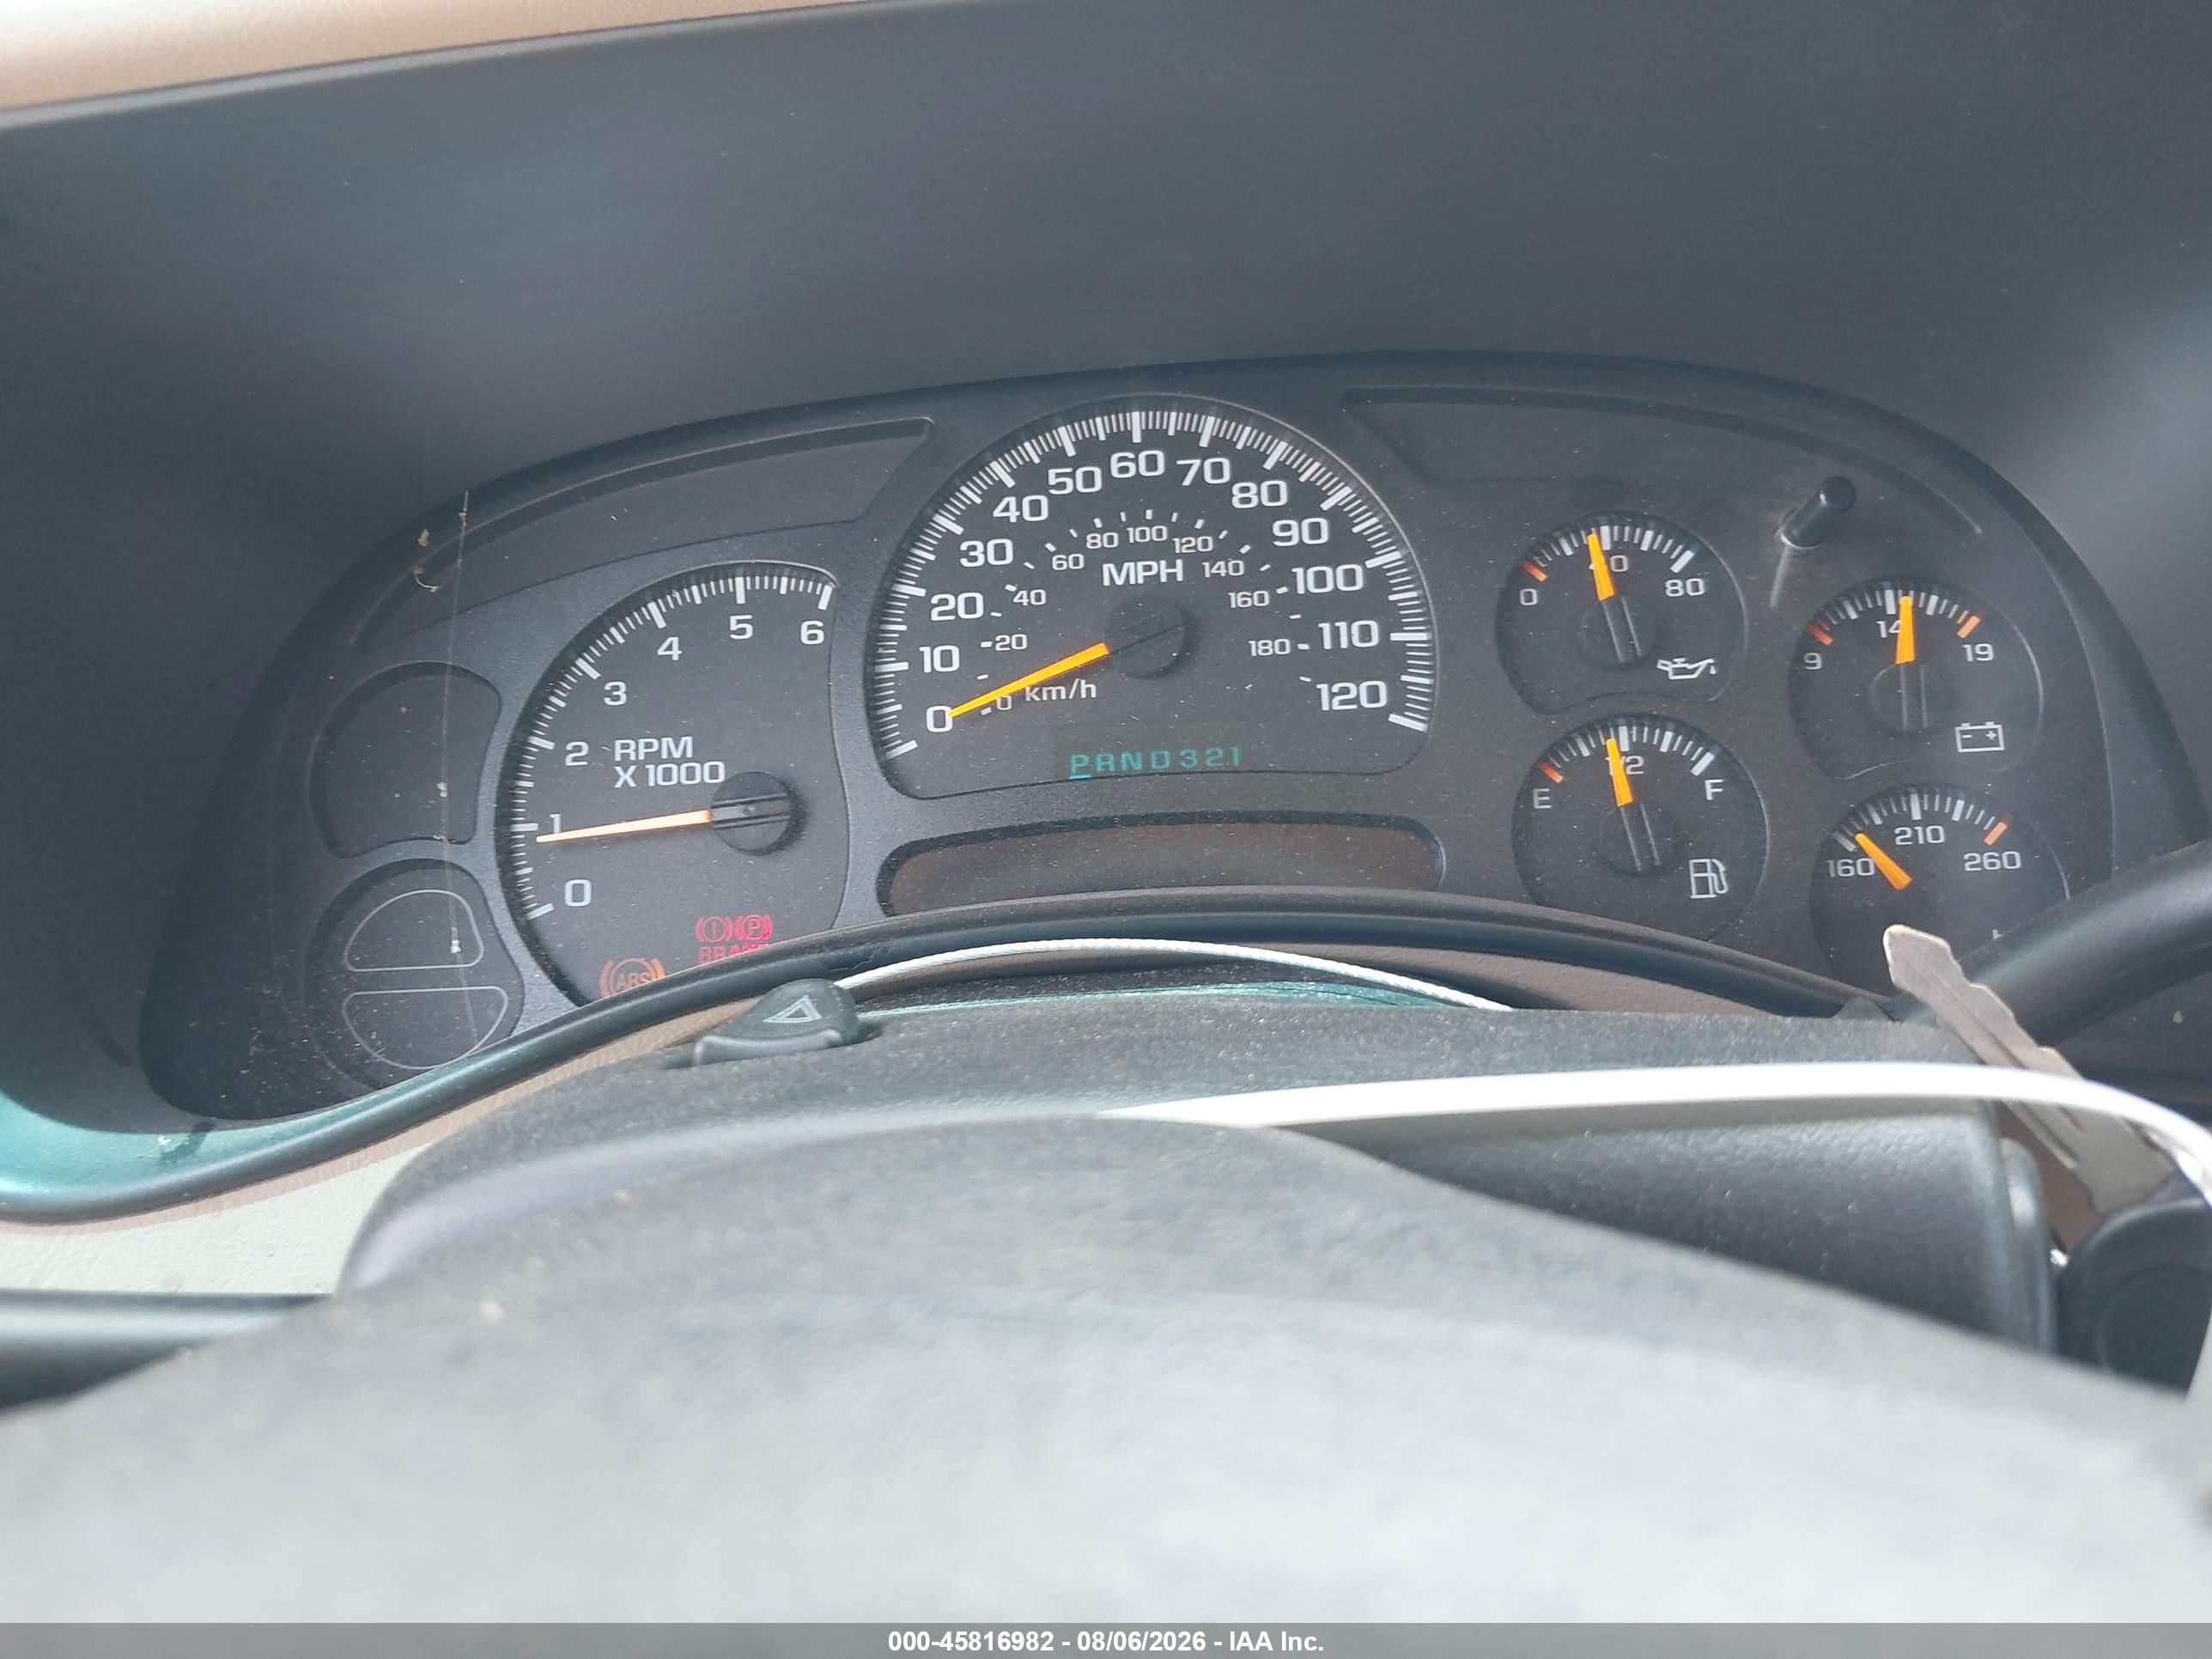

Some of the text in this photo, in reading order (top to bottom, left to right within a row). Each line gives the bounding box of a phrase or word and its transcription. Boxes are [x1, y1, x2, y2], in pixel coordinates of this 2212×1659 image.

[1111, 450, 1164, 477] 60
[1176, 458, 1231, 485] 70
[1048, 467, 1102, 495] 50
[1232, 480, 1287, 508] 80
[994, 495, 1048, 522] 40
[1086, 532, 1118, 549] 80
[1127, 526, 1167, 543] 100
[1273, 518, 1328, 546] 90
[960, 539, 1013, 567] 30
[1173, 537, 1213, 553] 120
[1052, 554, 1084, 570] 60
[1103, 559, 1182, 586] MPH
[1202, 561, 1244, 577] 140
[1589, 555, 1629, 573] 0
[1291, 564, 1364, 594] 100
[1666, 578, 1705, 597] 80
[931, 592, 983, 621] 20
[1013, 589, 1047, 606] 40
[1228, 591, 1269, 608] 160
[1520, 589, 1537, 605] 0
[730, 615, 753, 639] 5
[801, 621, 823, 644] 6
[1318, 621, 1379, 649] 110
[658, 637, 682, 660] 4
[995, 635, 1027, 651] 20
[1249, 639, 1290, 656] 180
[1963, 644, 1994, 661] 19
[920, 646, 959, 672] 10
[1805, 653, 1822, 669] 9
[605, 682, 626, 705] 3
[1025, 678, 1098, 702] km/h
[1316, 681, 1387, 710] 120
[996, 695, 1012, 710] 0
[927, 706, 952, 732] 0
[566, 742, 588, 766] 2
[615, 737, 692, 761] RPM
[614, 762, 725, 787] X 1000
[1534, 788, 1552, 809] E
[1705, 780, 1723, 800] F
[550, 814, 561, 834] 1
[1894, 826, 1945, 845] 210
[1826, 859, 1875, 878] 160
[1964, 851, 2021, 871] 260
[565, 879, 591, 906] 0
